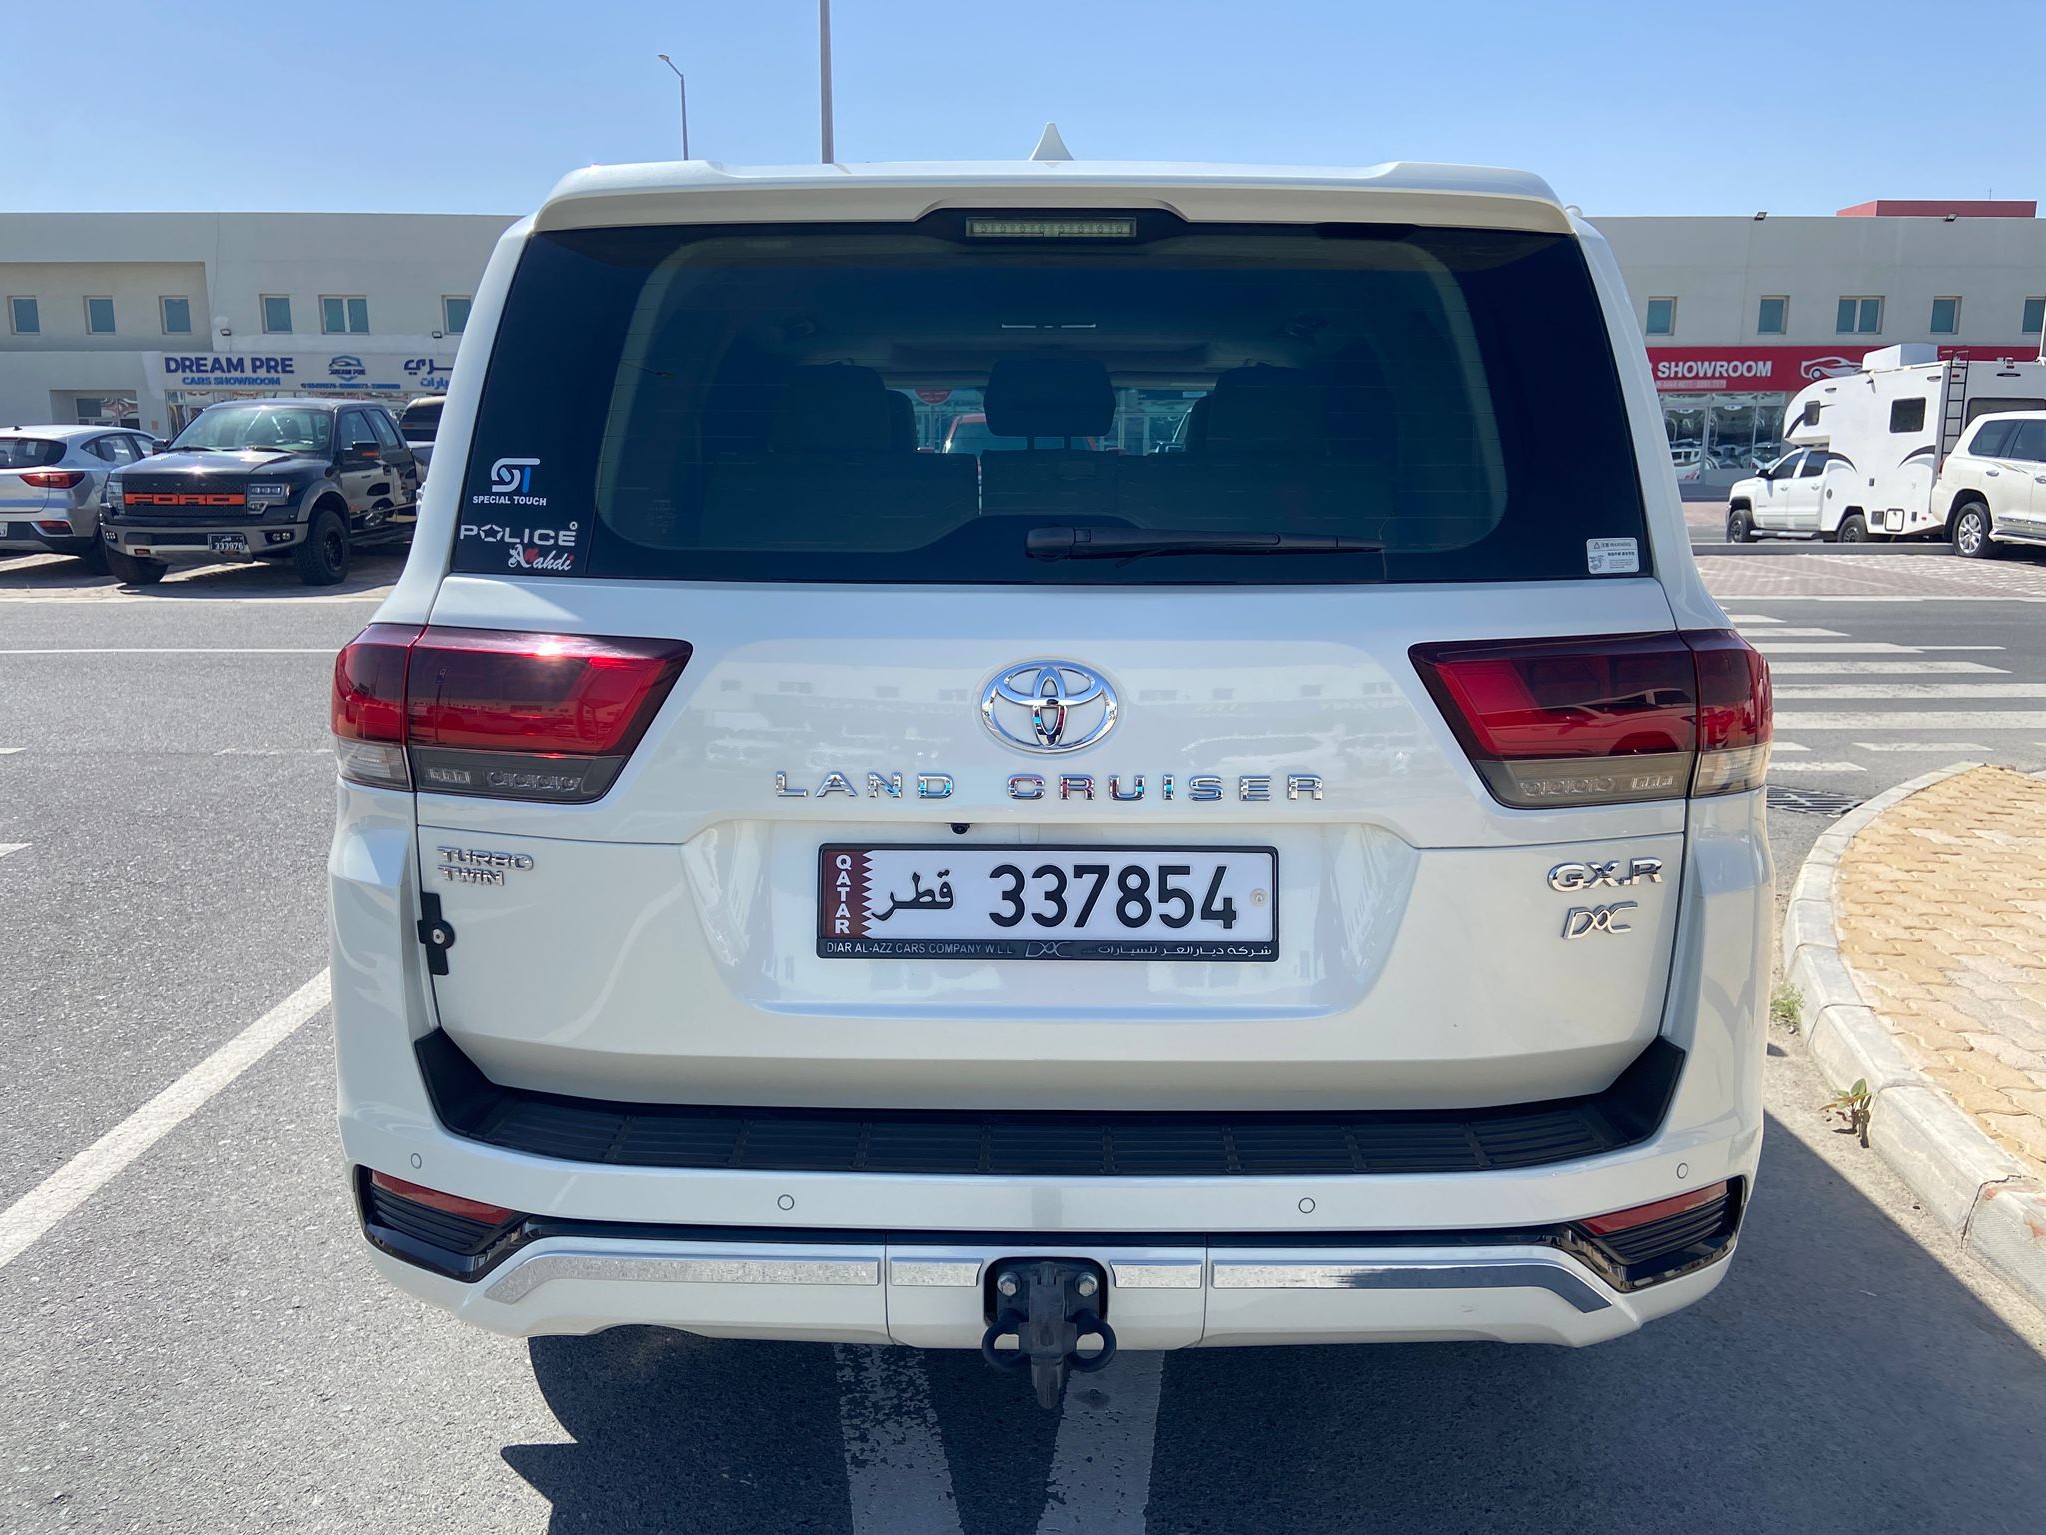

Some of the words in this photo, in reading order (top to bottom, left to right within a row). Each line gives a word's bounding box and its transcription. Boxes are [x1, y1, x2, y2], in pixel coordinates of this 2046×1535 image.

[164, 357, 245, 373] DREAM
[251, 357, 295, 374] PRE
[1657, 360, 1773, 378] SHOWROOM
[182, 377, 211, 386] CARS
[213, 377, 281, 386] SHOWROOM
[124, 493, 245, 505] FORD
[472, 495, 511, 504] SPECIAL
[513, 496, 547, 506] TOUCH
[774, 770, 955, 799] LAND
[1006, 773, 1325, 801] CRUISER
[437, 846, 534, 872] TURBO
[437, 864, 505, 887] TWIN
[835, 854, 852, 934] QATAR
[871, 869, 954, 921] قطر
[988, 864, 1237, 929] 337854
[826, 943, 852, 954] DIAR
[854, 943, 892, 954] AL-AZZ
[895, 943, 926, 954] CARS
[929, 943, 982, 954] COMPANY
[1098, 945, 1158, 957] للسيارات
[1227, 945, 1271, 957] شركة
